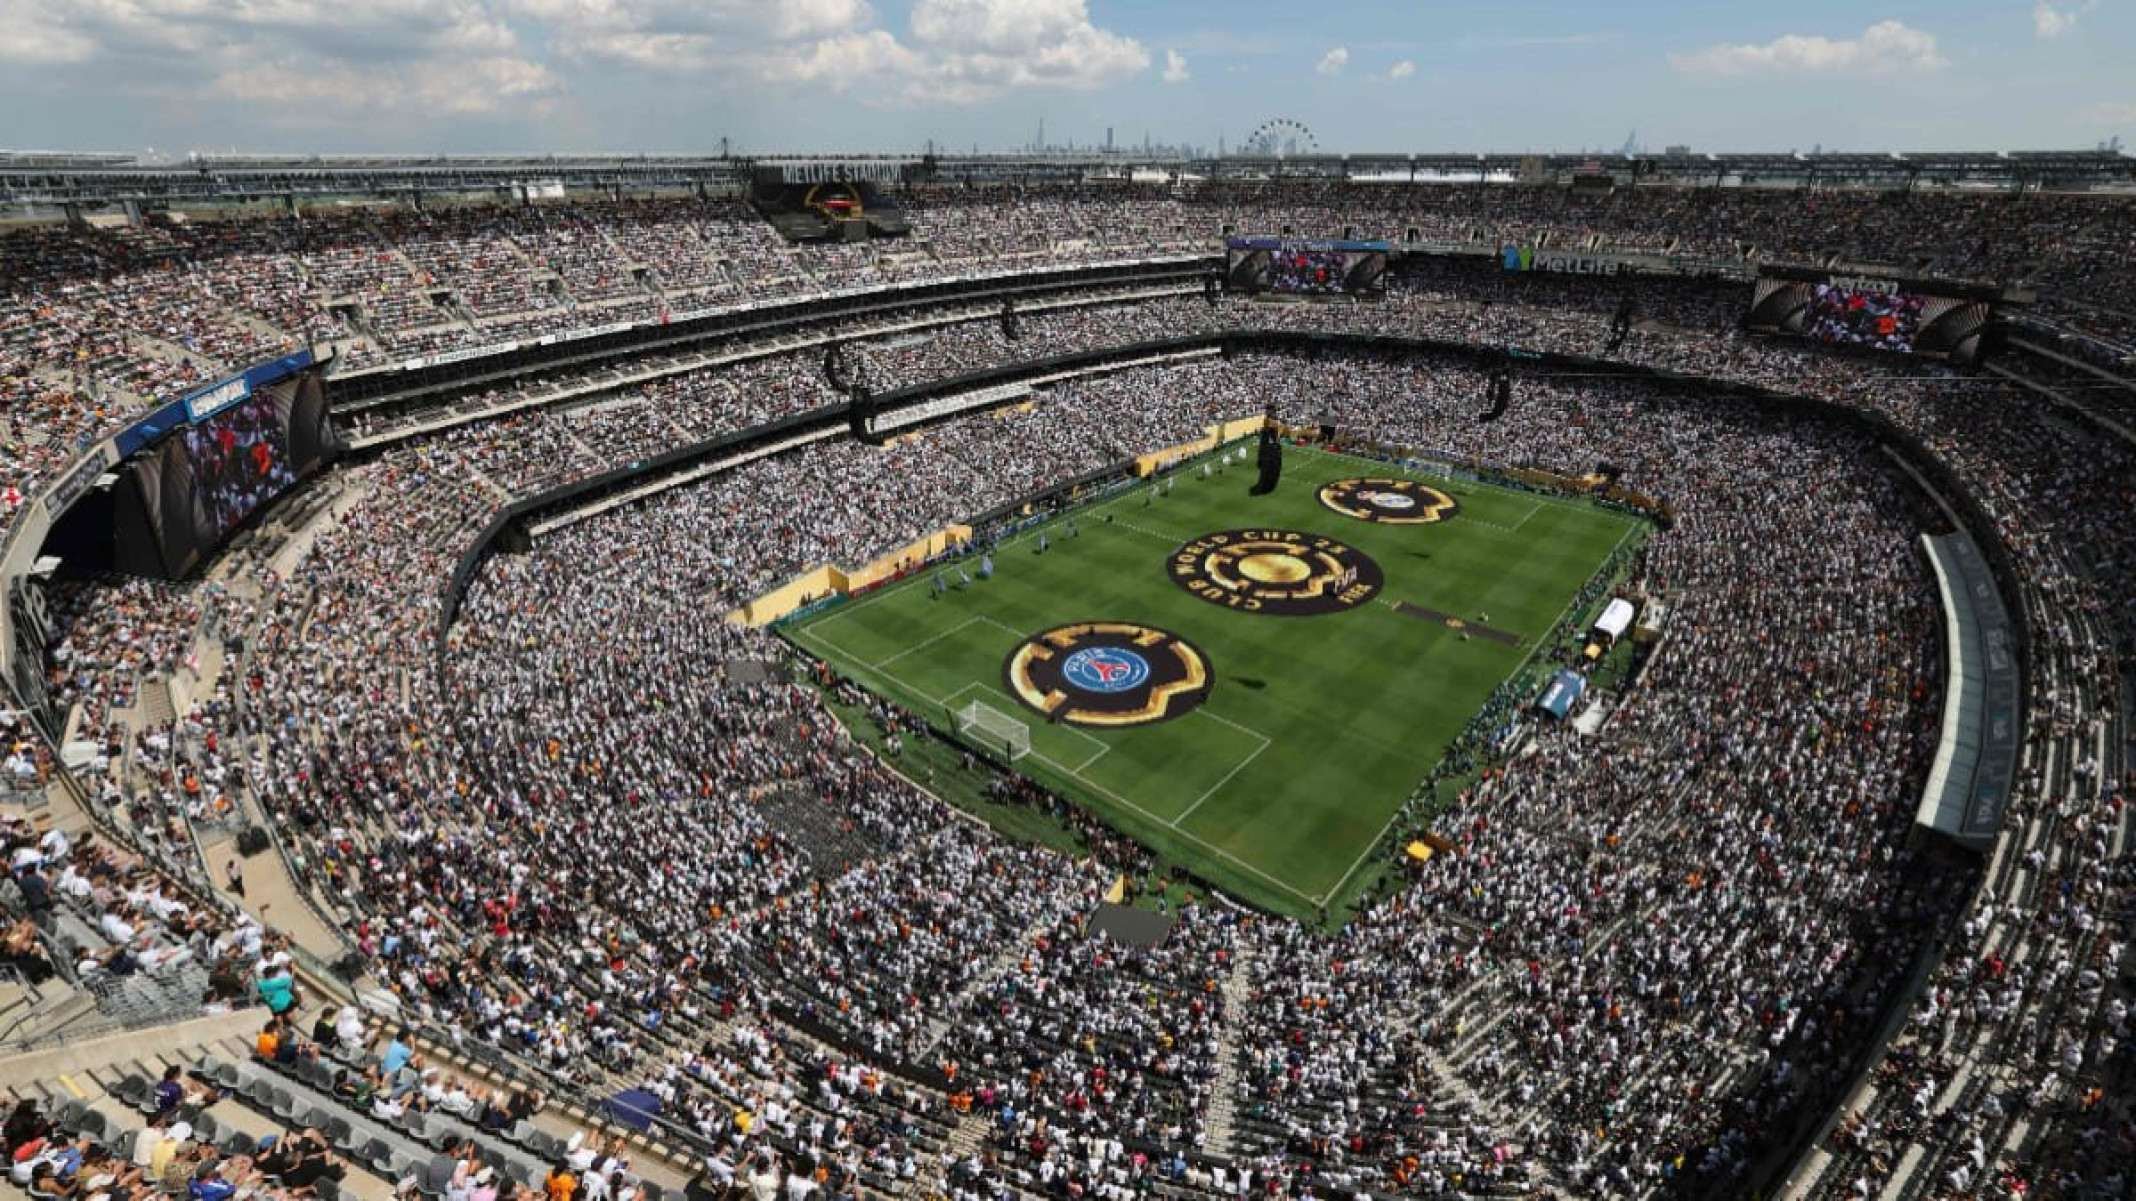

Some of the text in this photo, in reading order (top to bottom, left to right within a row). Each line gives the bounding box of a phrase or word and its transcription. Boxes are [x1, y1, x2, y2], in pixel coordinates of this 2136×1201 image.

[783, 162, 901, 183] METLIFE STADIUM
[1533, 253, 1617, 275] MetLife
[1829, 275, 1899, 297] verizon
[1243, 531, 1300, 541] CUP
[1175, 535, 1228, 575] WORLD
[1188, 580, 1262, 609] CLUB
